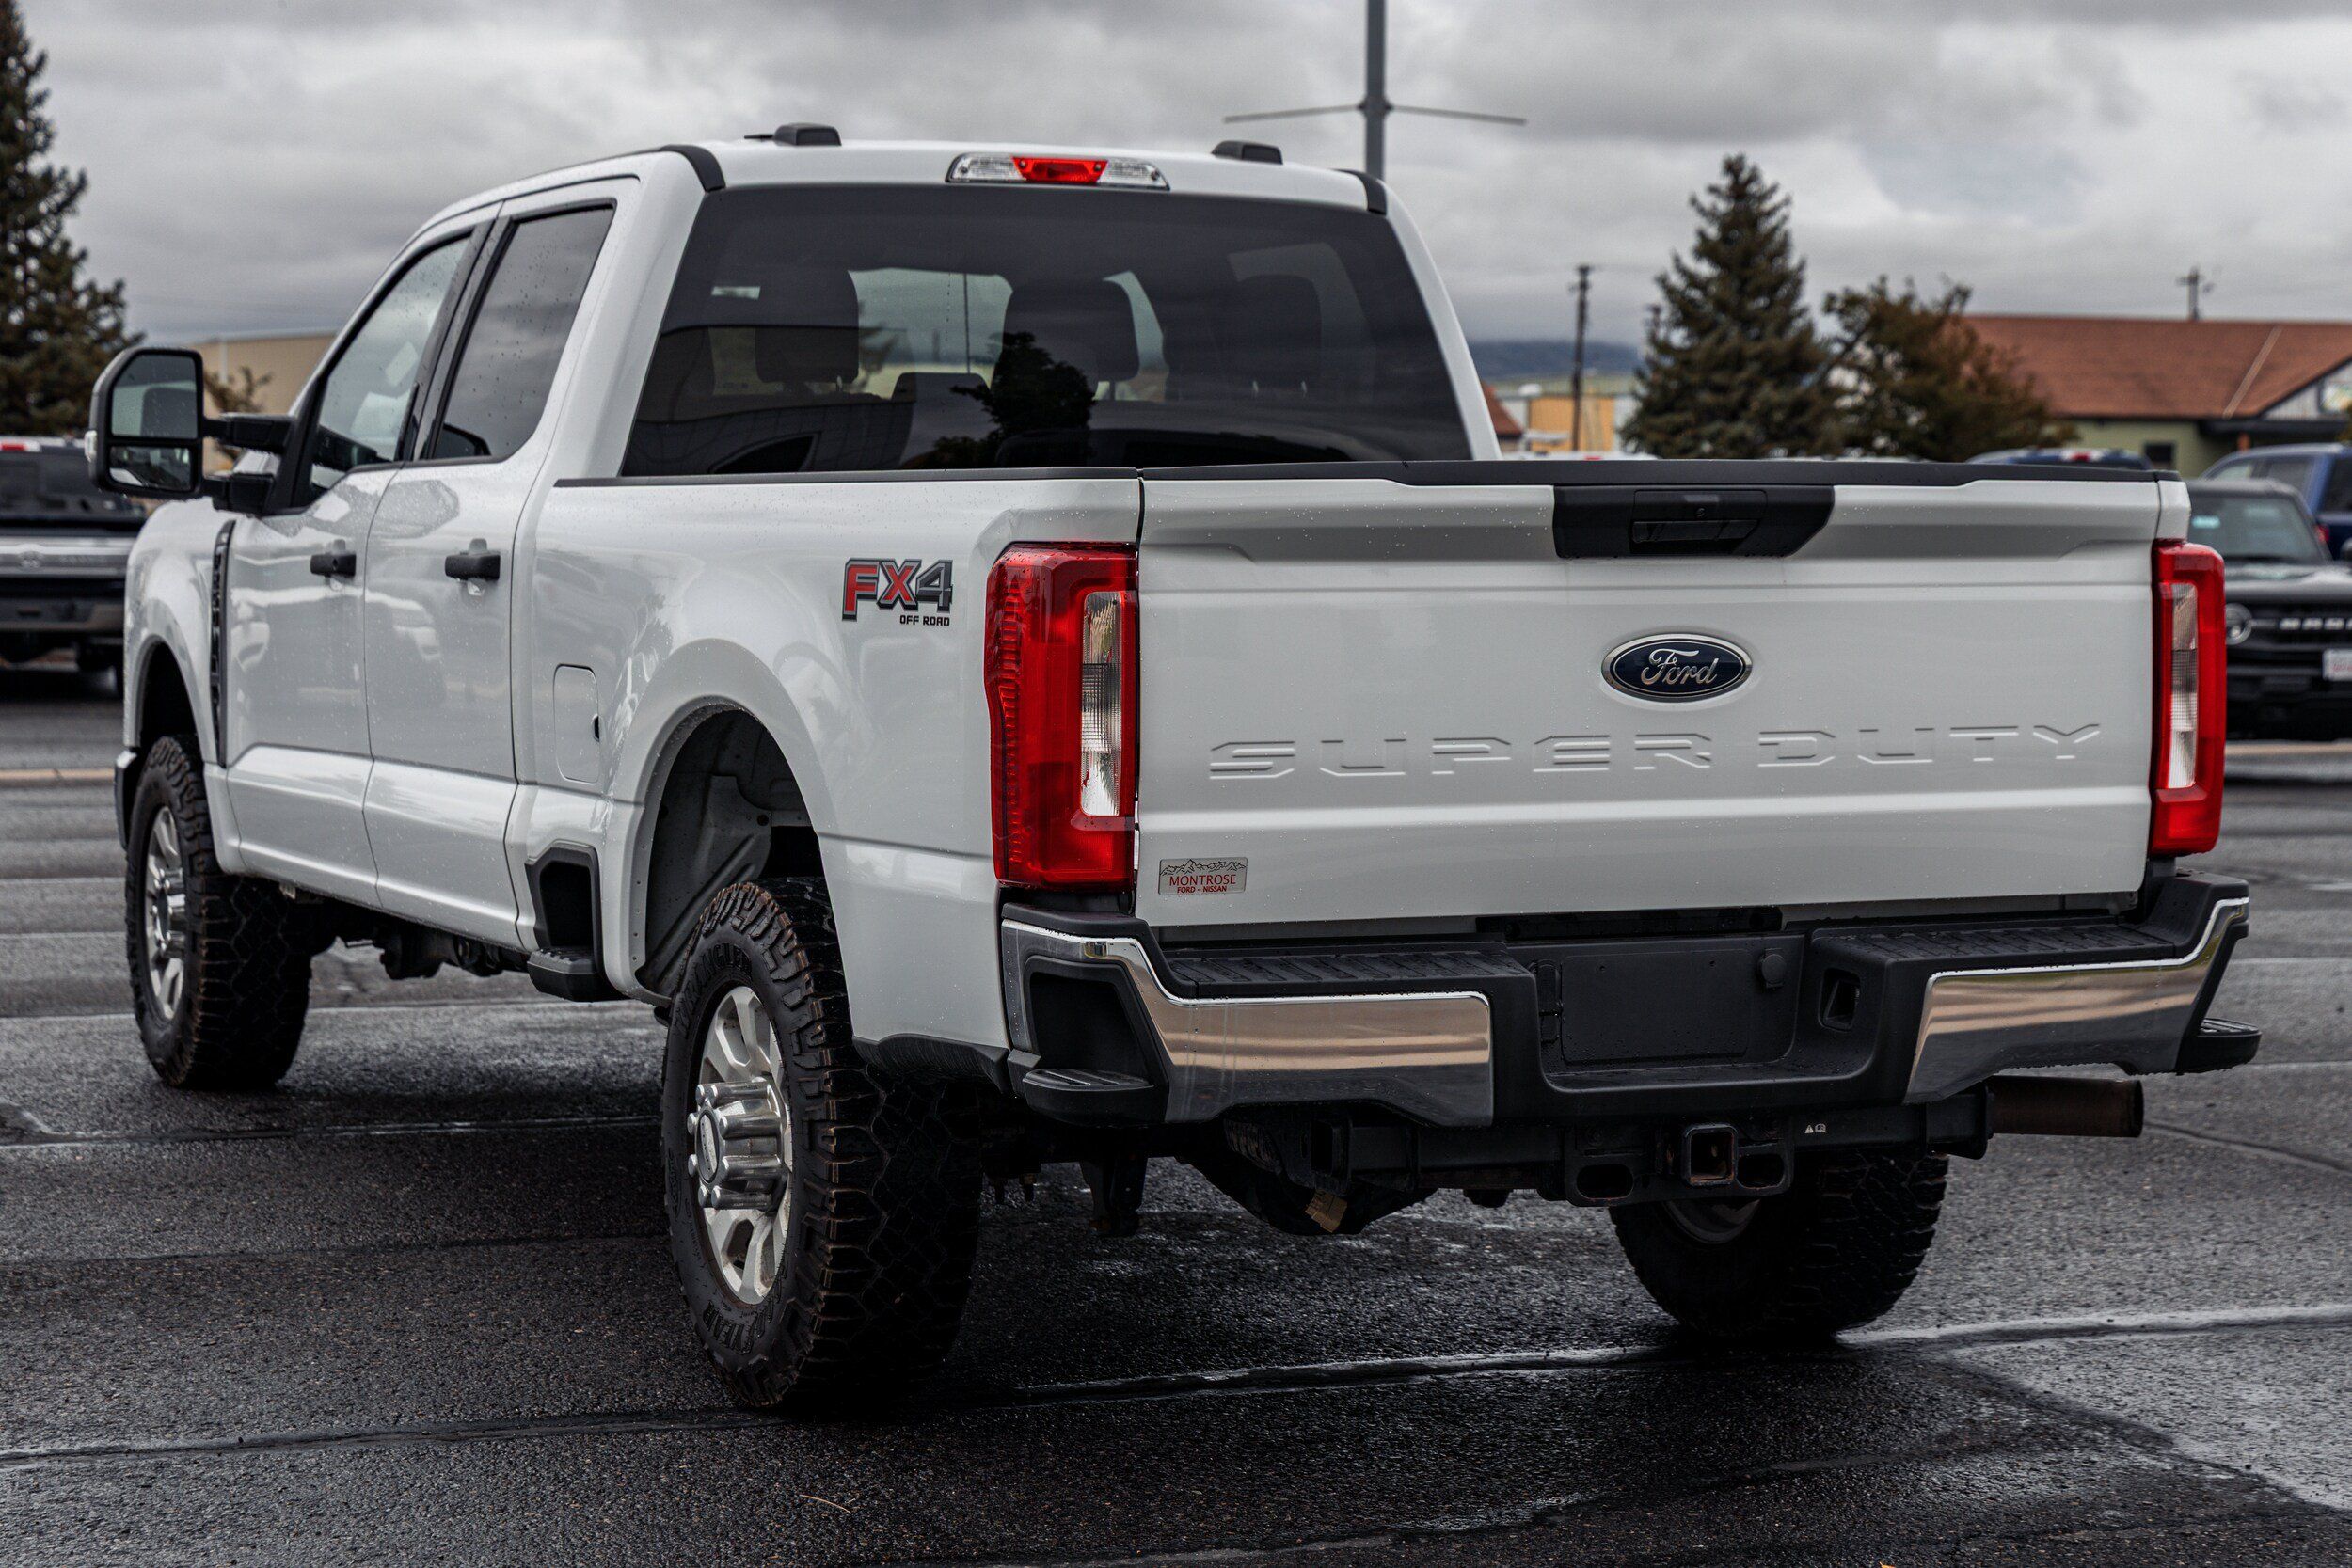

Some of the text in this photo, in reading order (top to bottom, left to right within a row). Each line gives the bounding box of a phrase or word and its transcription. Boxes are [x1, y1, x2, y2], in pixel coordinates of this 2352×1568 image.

[842, 558, 953, 622] FX4
[899, 614, 950, 627] OFF ROAD
[1641, 649, 1718, 685] Ford
[1210, 724, 2100, 780] SUPER DUTY
[1169, 875, 1236, 886] MONTROSE
[674, 942, 753, 1040] WRANGLER
